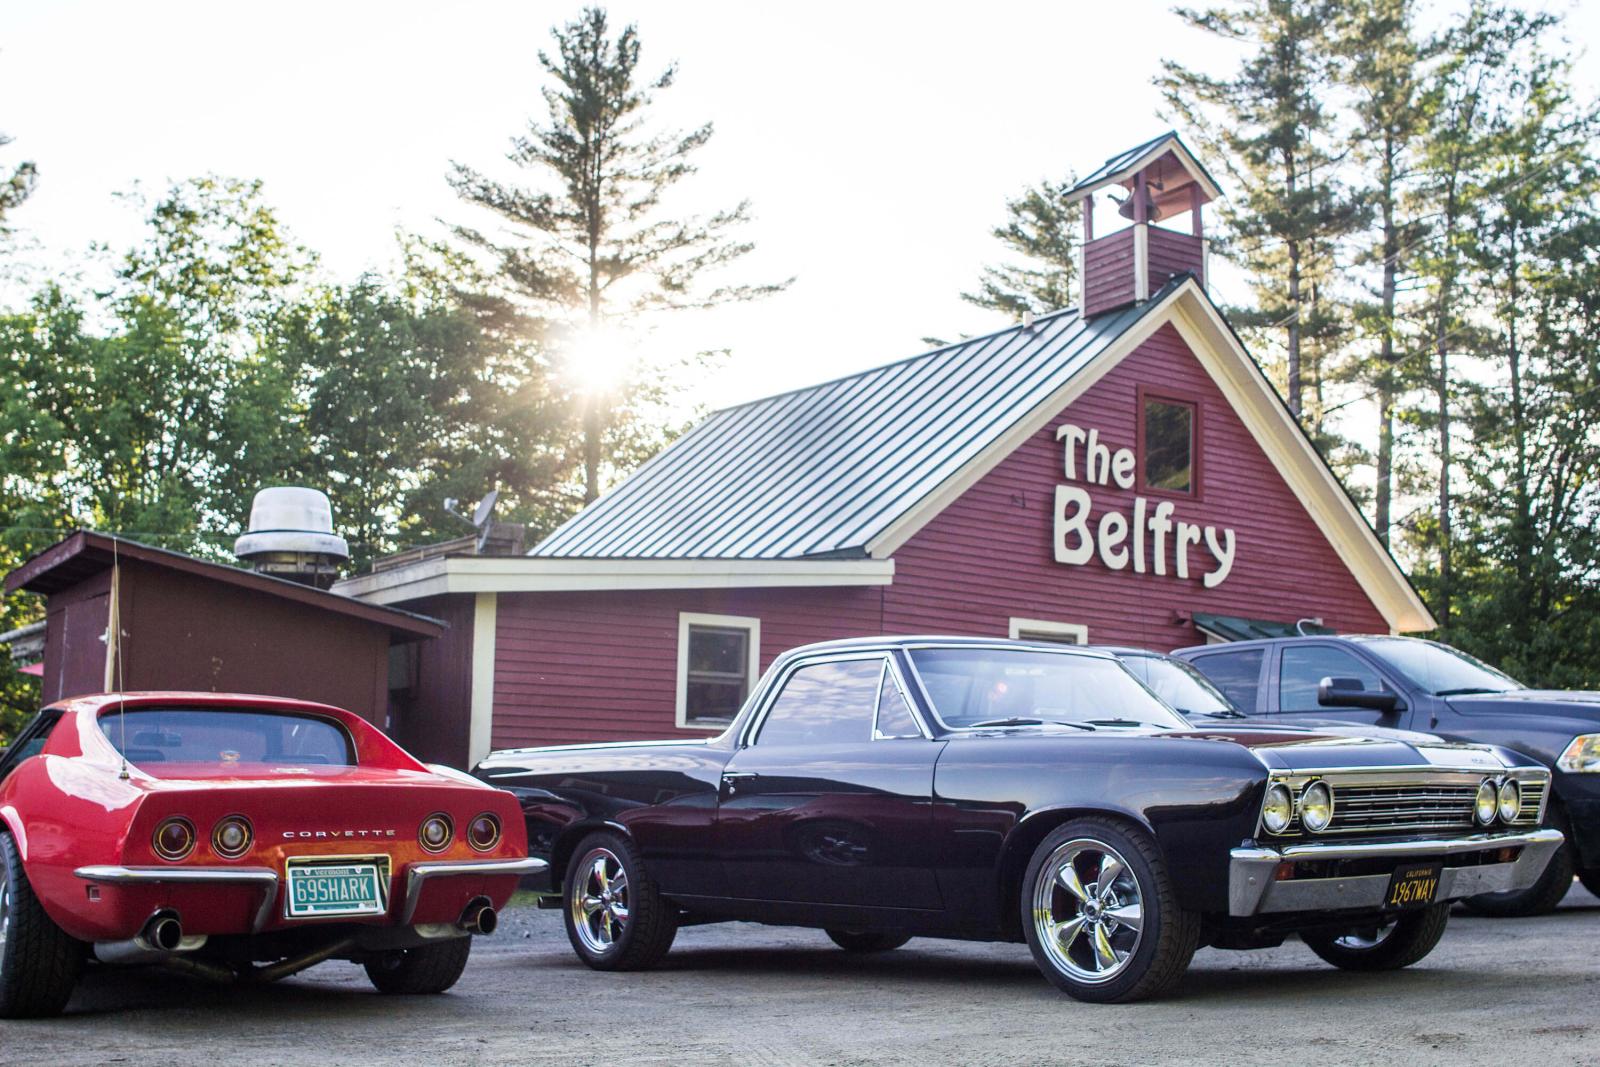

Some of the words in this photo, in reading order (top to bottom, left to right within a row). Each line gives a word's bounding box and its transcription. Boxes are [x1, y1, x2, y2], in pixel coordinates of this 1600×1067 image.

[1056, 424, 1136, 489] The
[1054, 485, 1236, 588] Belfry
[282, 830, 396, 838] CORVETTE
[296, 877, 370, 902] 69SHARK
[1391, 879, 1437, 904] 1967WAY
